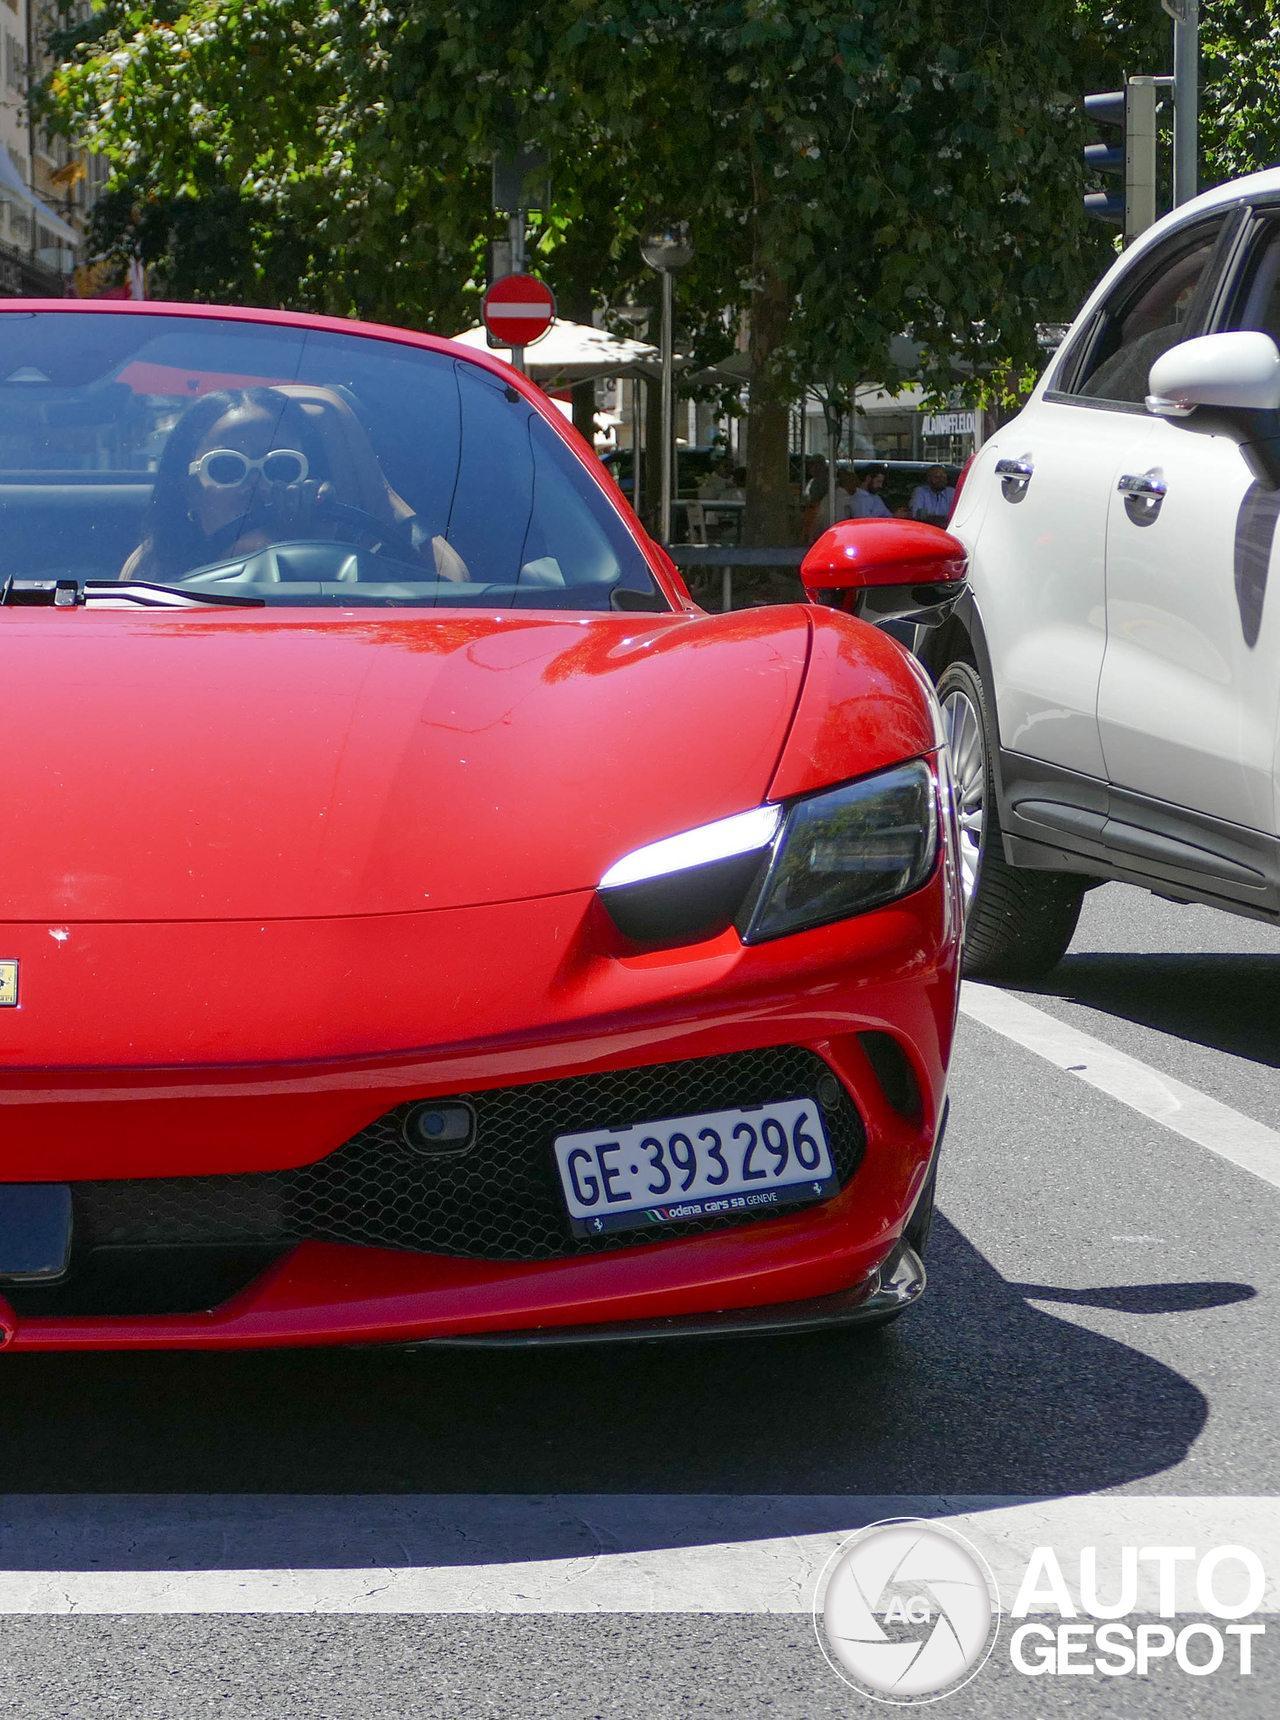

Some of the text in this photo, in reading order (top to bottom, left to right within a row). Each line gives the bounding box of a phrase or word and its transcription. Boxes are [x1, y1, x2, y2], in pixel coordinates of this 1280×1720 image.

[704, 1199, 730, 1213] cars
[731, 1196, 746, 1208] sa
[746, 1191, 778, 1206] GENEVE
